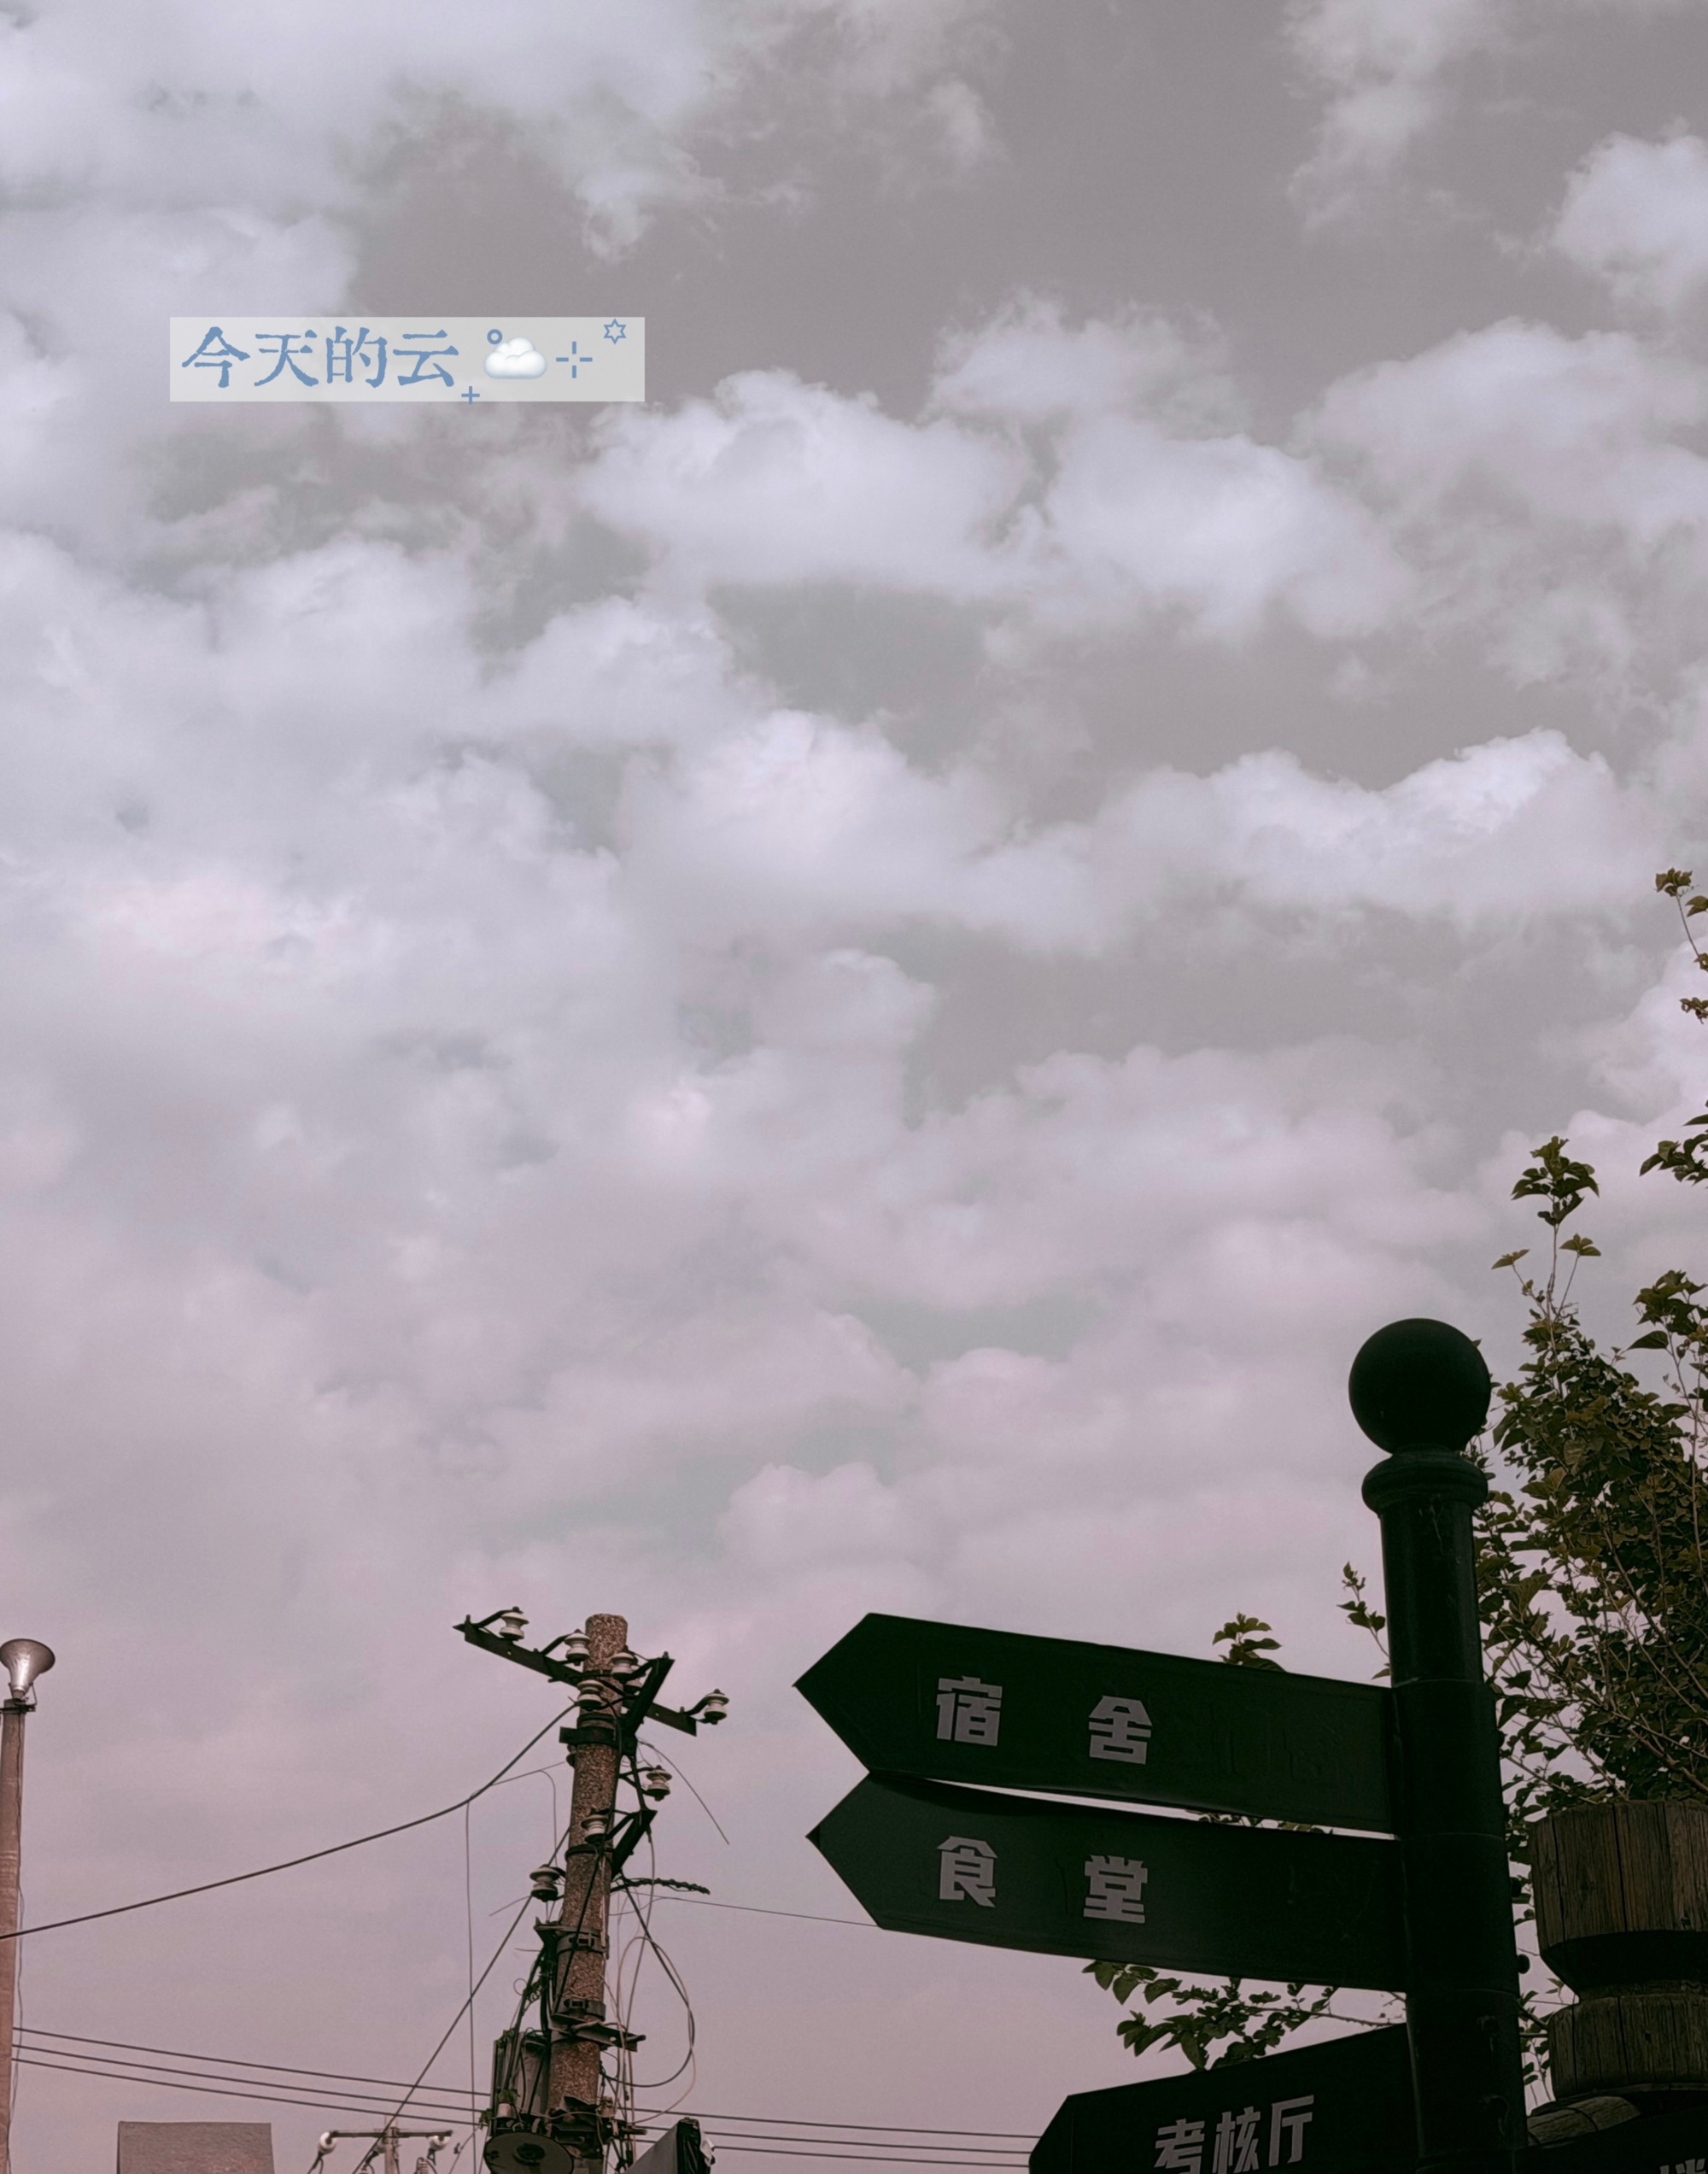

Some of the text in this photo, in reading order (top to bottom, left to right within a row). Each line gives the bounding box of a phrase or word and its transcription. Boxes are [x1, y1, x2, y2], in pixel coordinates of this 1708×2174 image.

[936, 1675, 1153, 1766] 宿舍
[936, 1836, 1149, 1925] 食堂
[1153, 2095, 1315, 2174] 考核厅
